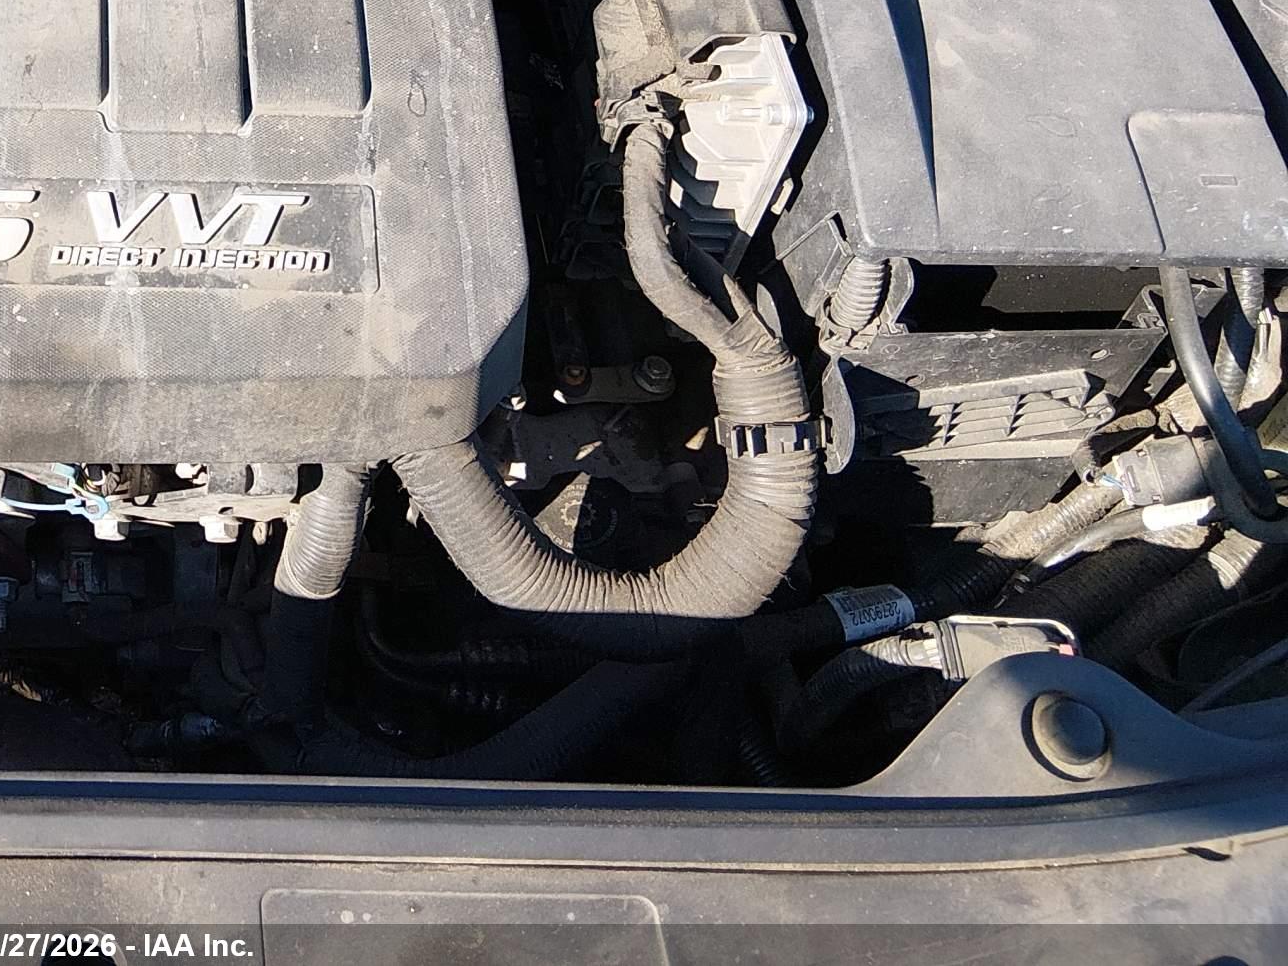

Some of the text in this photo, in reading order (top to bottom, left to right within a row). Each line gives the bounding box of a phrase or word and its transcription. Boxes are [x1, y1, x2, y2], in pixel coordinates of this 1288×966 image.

[86, 190, 310, 246] VVT
[51, 244, 332, 273] DIRECT INJECTION
